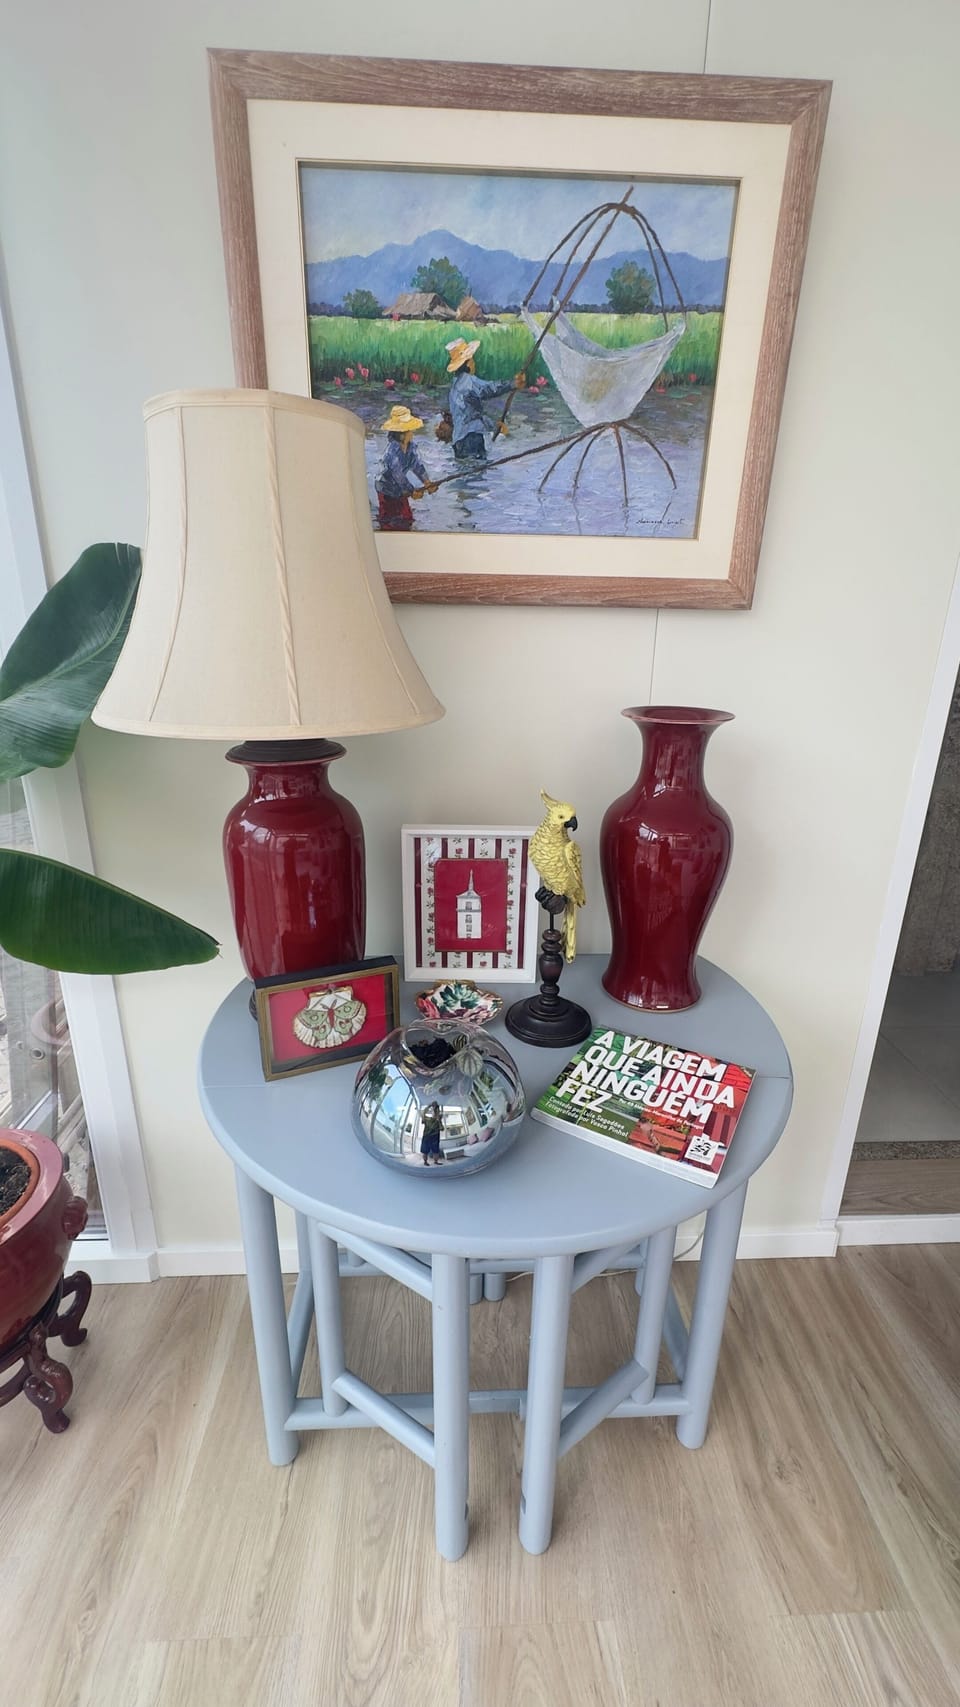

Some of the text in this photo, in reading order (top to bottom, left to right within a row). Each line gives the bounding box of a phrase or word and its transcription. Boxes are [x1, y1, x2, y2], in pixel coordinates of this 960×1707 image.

[584, 1045, 735, 1108] QUE AINDA
[595, 1030, 727, 1081] A VIAGEM
[556, 1079, 612, 1113] FEZ
[570, 1061, 714, 1124] NINGUÉM
